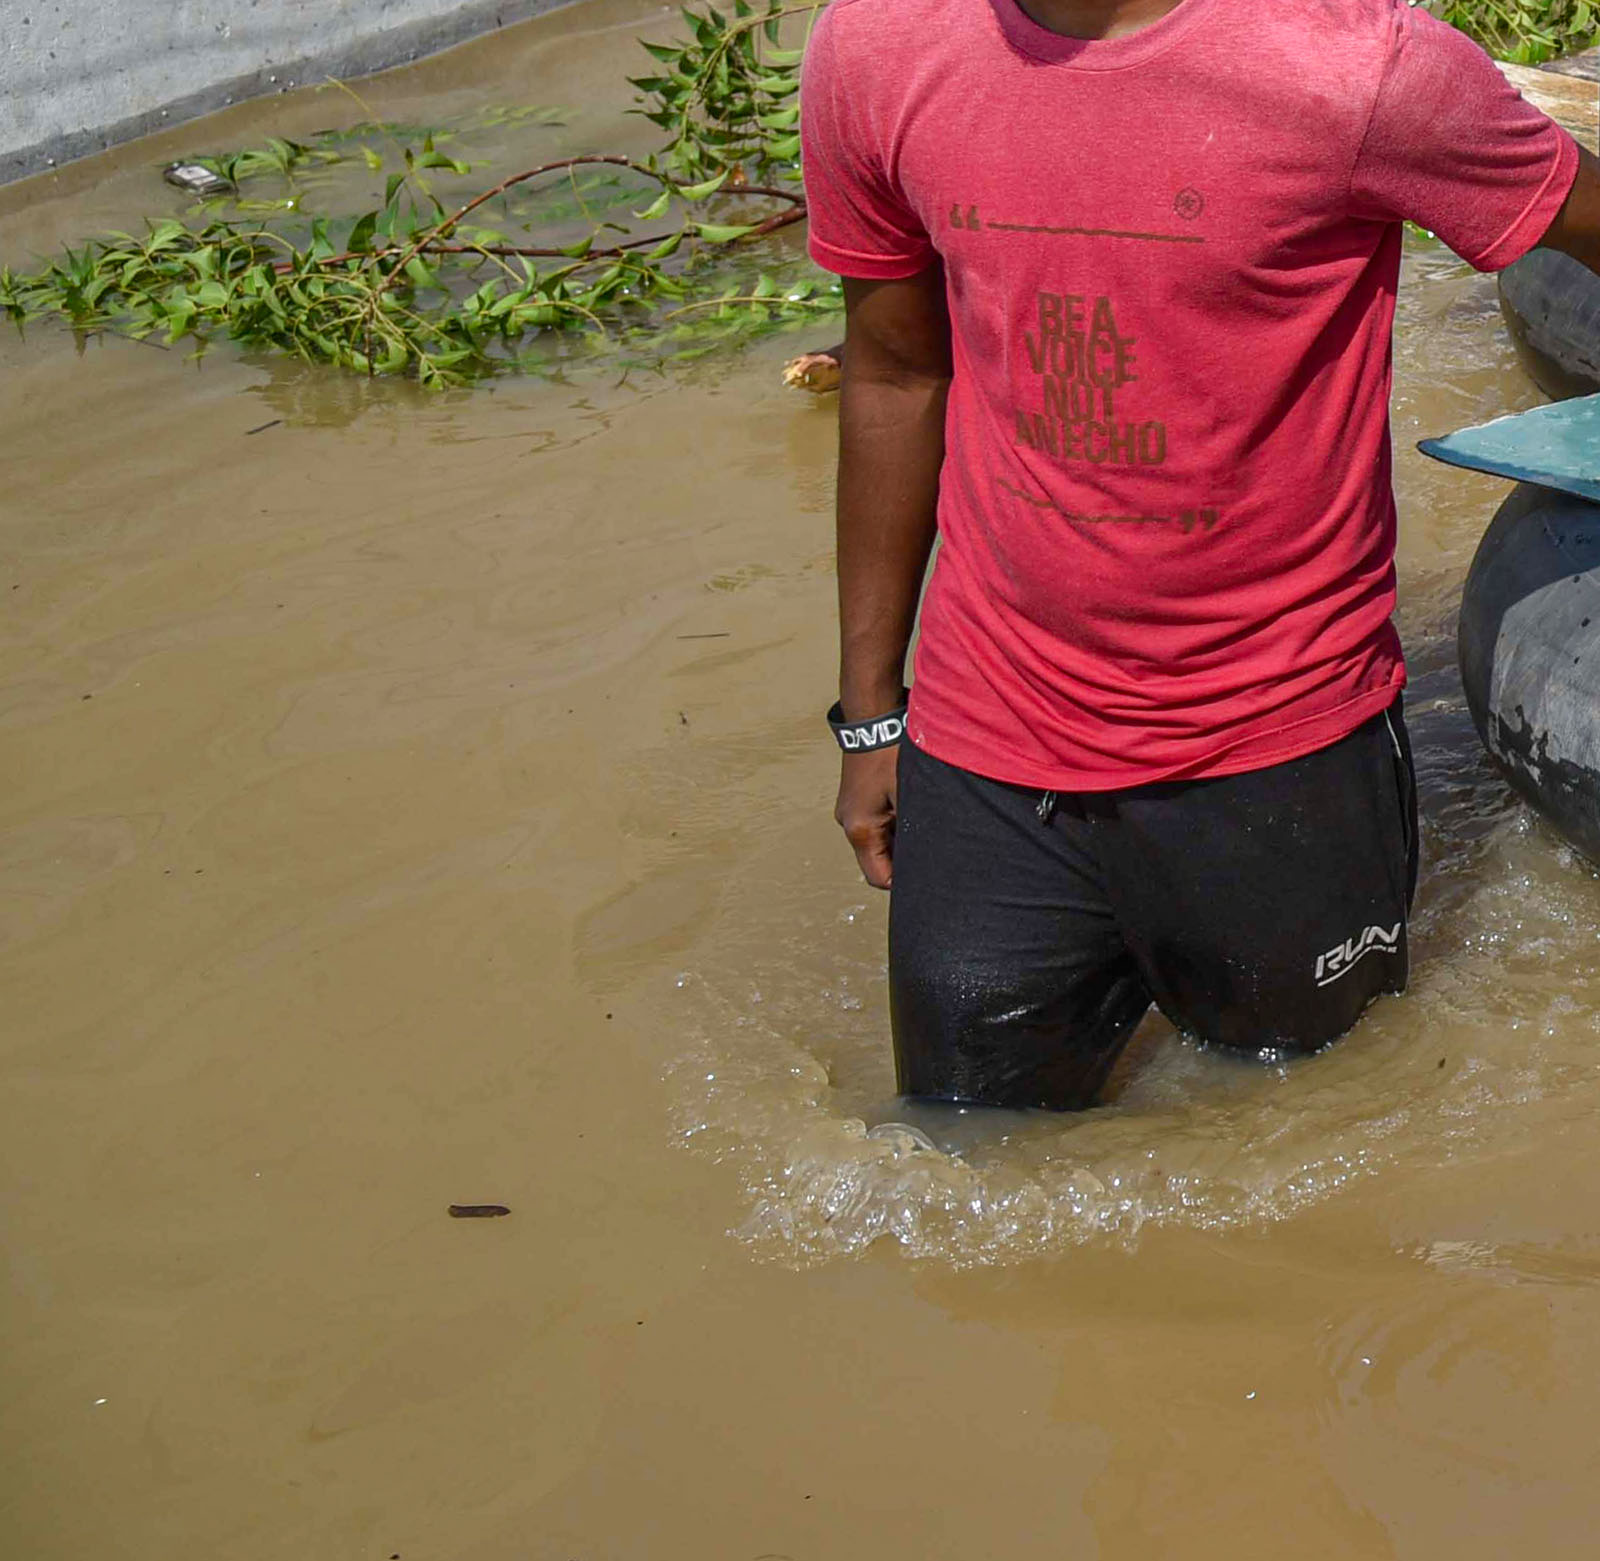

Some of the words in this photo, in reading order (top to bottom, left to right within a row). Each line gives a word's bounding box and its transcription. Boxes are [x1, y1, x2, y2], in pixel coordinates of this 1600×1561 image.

[1038, 291, 1085, 337] BE
[1090, 296, 1120, 342] A
[1025, 330, 1138, 388] VOICE
[1043, 367, 1115, 424] NOT
[1016, 408, 1060, 458] AN
[1064, 419, 1168, 465] ECHO
[1315, 922, 1402, 979] RUN
